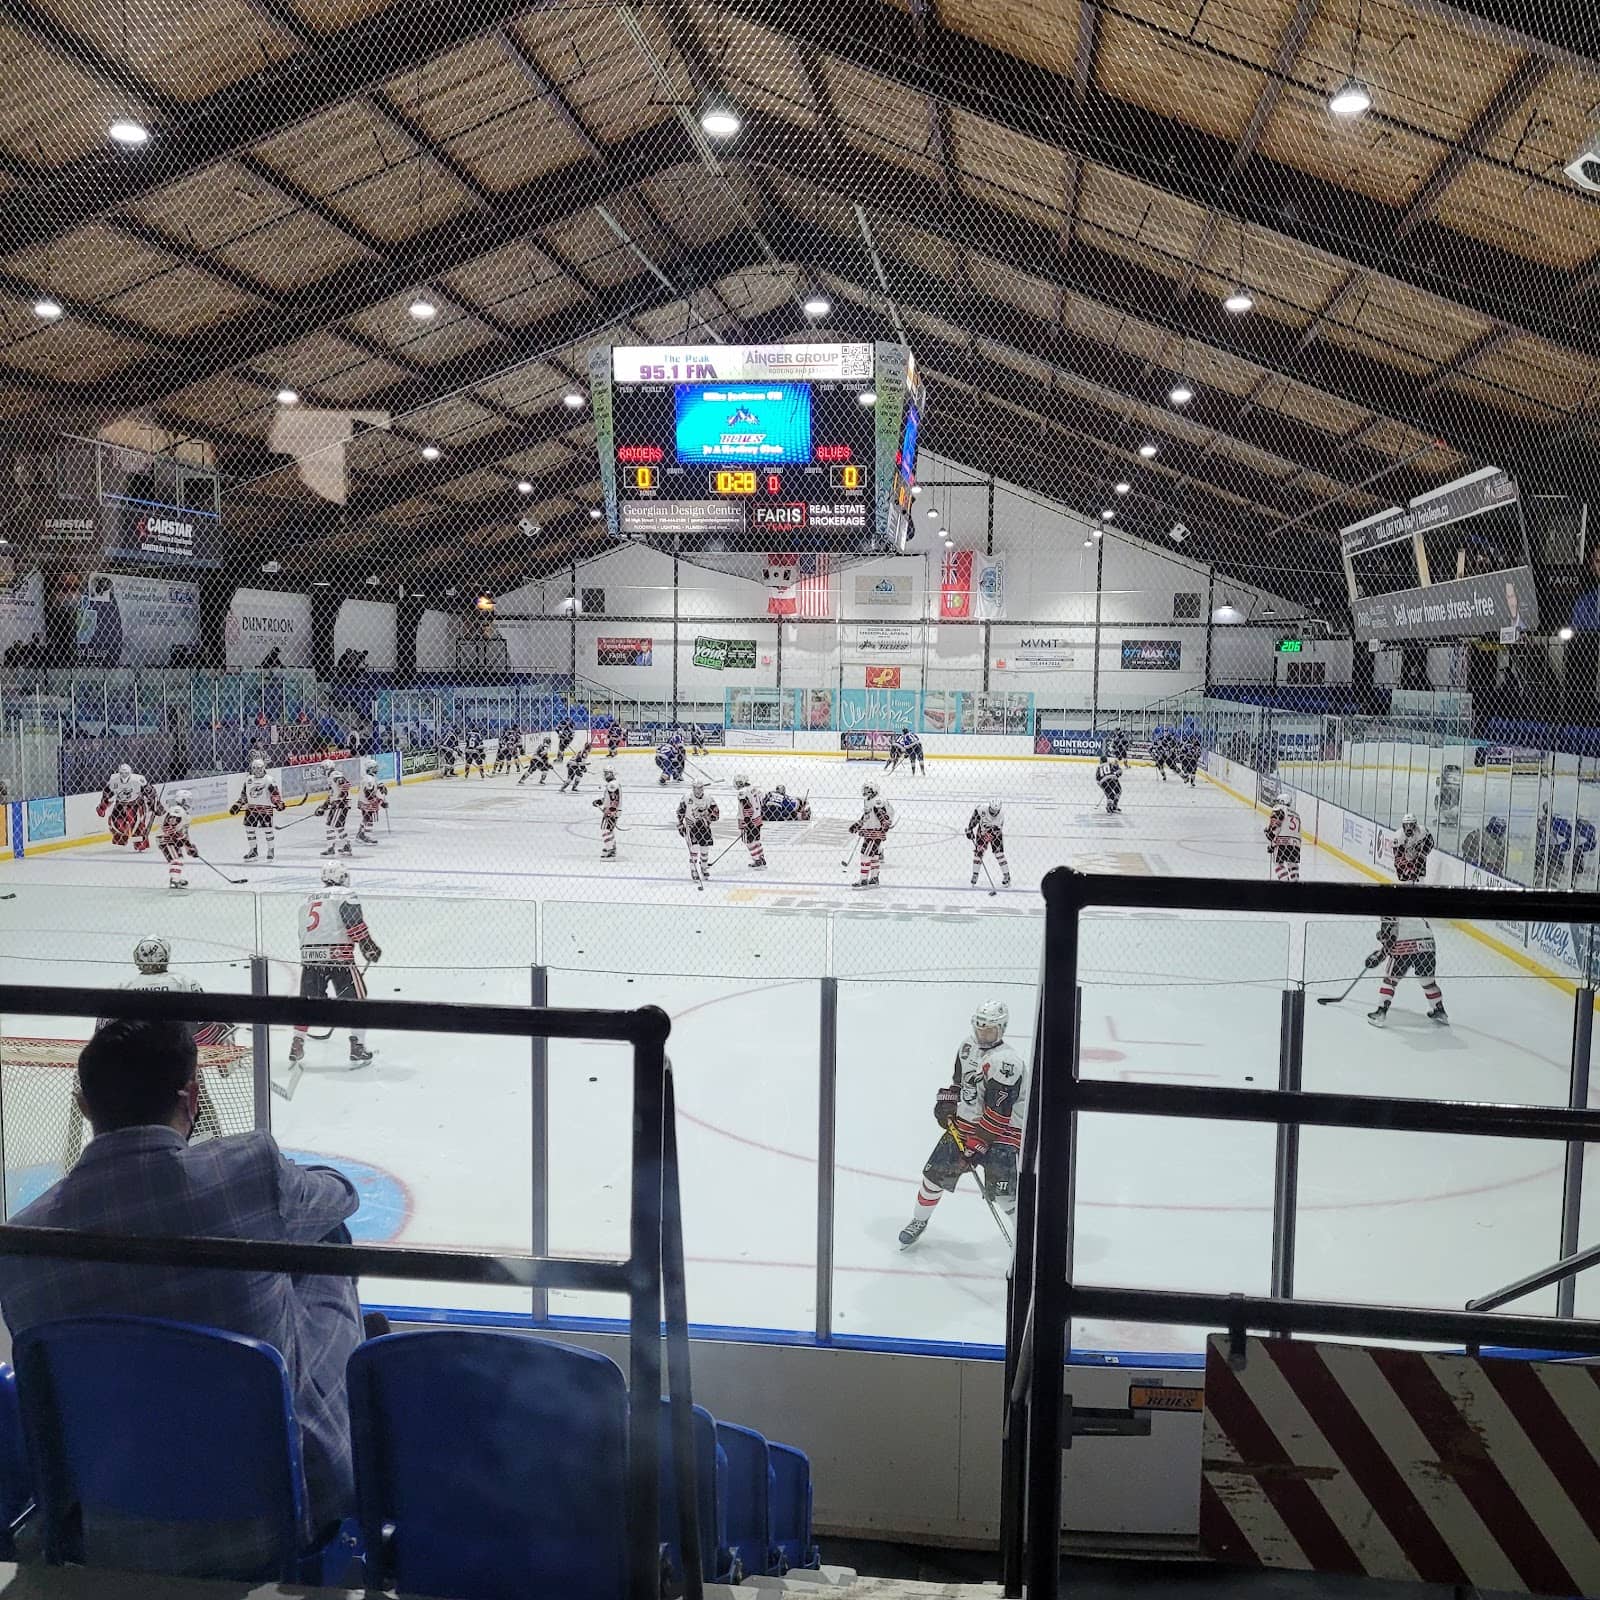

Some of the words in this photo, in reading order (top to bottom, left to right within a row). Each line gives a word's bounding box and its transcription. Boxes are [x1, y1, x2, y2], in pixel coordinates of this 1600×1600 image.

[796, 353, 839, 364] GROUP
[640, 365, 679, 380] 95.1
[687, 364, 718, 379] FM
[619, 447, 663, 460] RAIDERS
[817, 445, 851, 459] BLUES
[638, 468, 650, 488] 0
[769, 475, 778, 491] 0
[845, 467, 857, 488] 0
[623, 504, 668, 517] Georgian
[671, 504, 705, 517] Design
[707, 504, 742, 516] Centre
[757, 508, 801, 522] FARIS
[809, 504, 832, 514] REAL
[834, 504, 866, 514] ESTATE
[147, 518, 193, 538] CARSTAR
[809, 516, 866, 526] BROKERAGE
[1393, 602, 1408, 627] Sell
[1407, 606, 1424, 631] your
[1423, 599, 1449, 623] home
[1447, 591, 1495, 619] stress-free
[242, 616, 294, 633] DUNTROON
[1020, 639, 1060, 649] MVMT
[1053, 739, 1102, 750] DUNTROON
[306, 901, 323, 932] 5
[308, 950, 328, 960] WINGS
[996, 1090, 1009, 1107] 7
